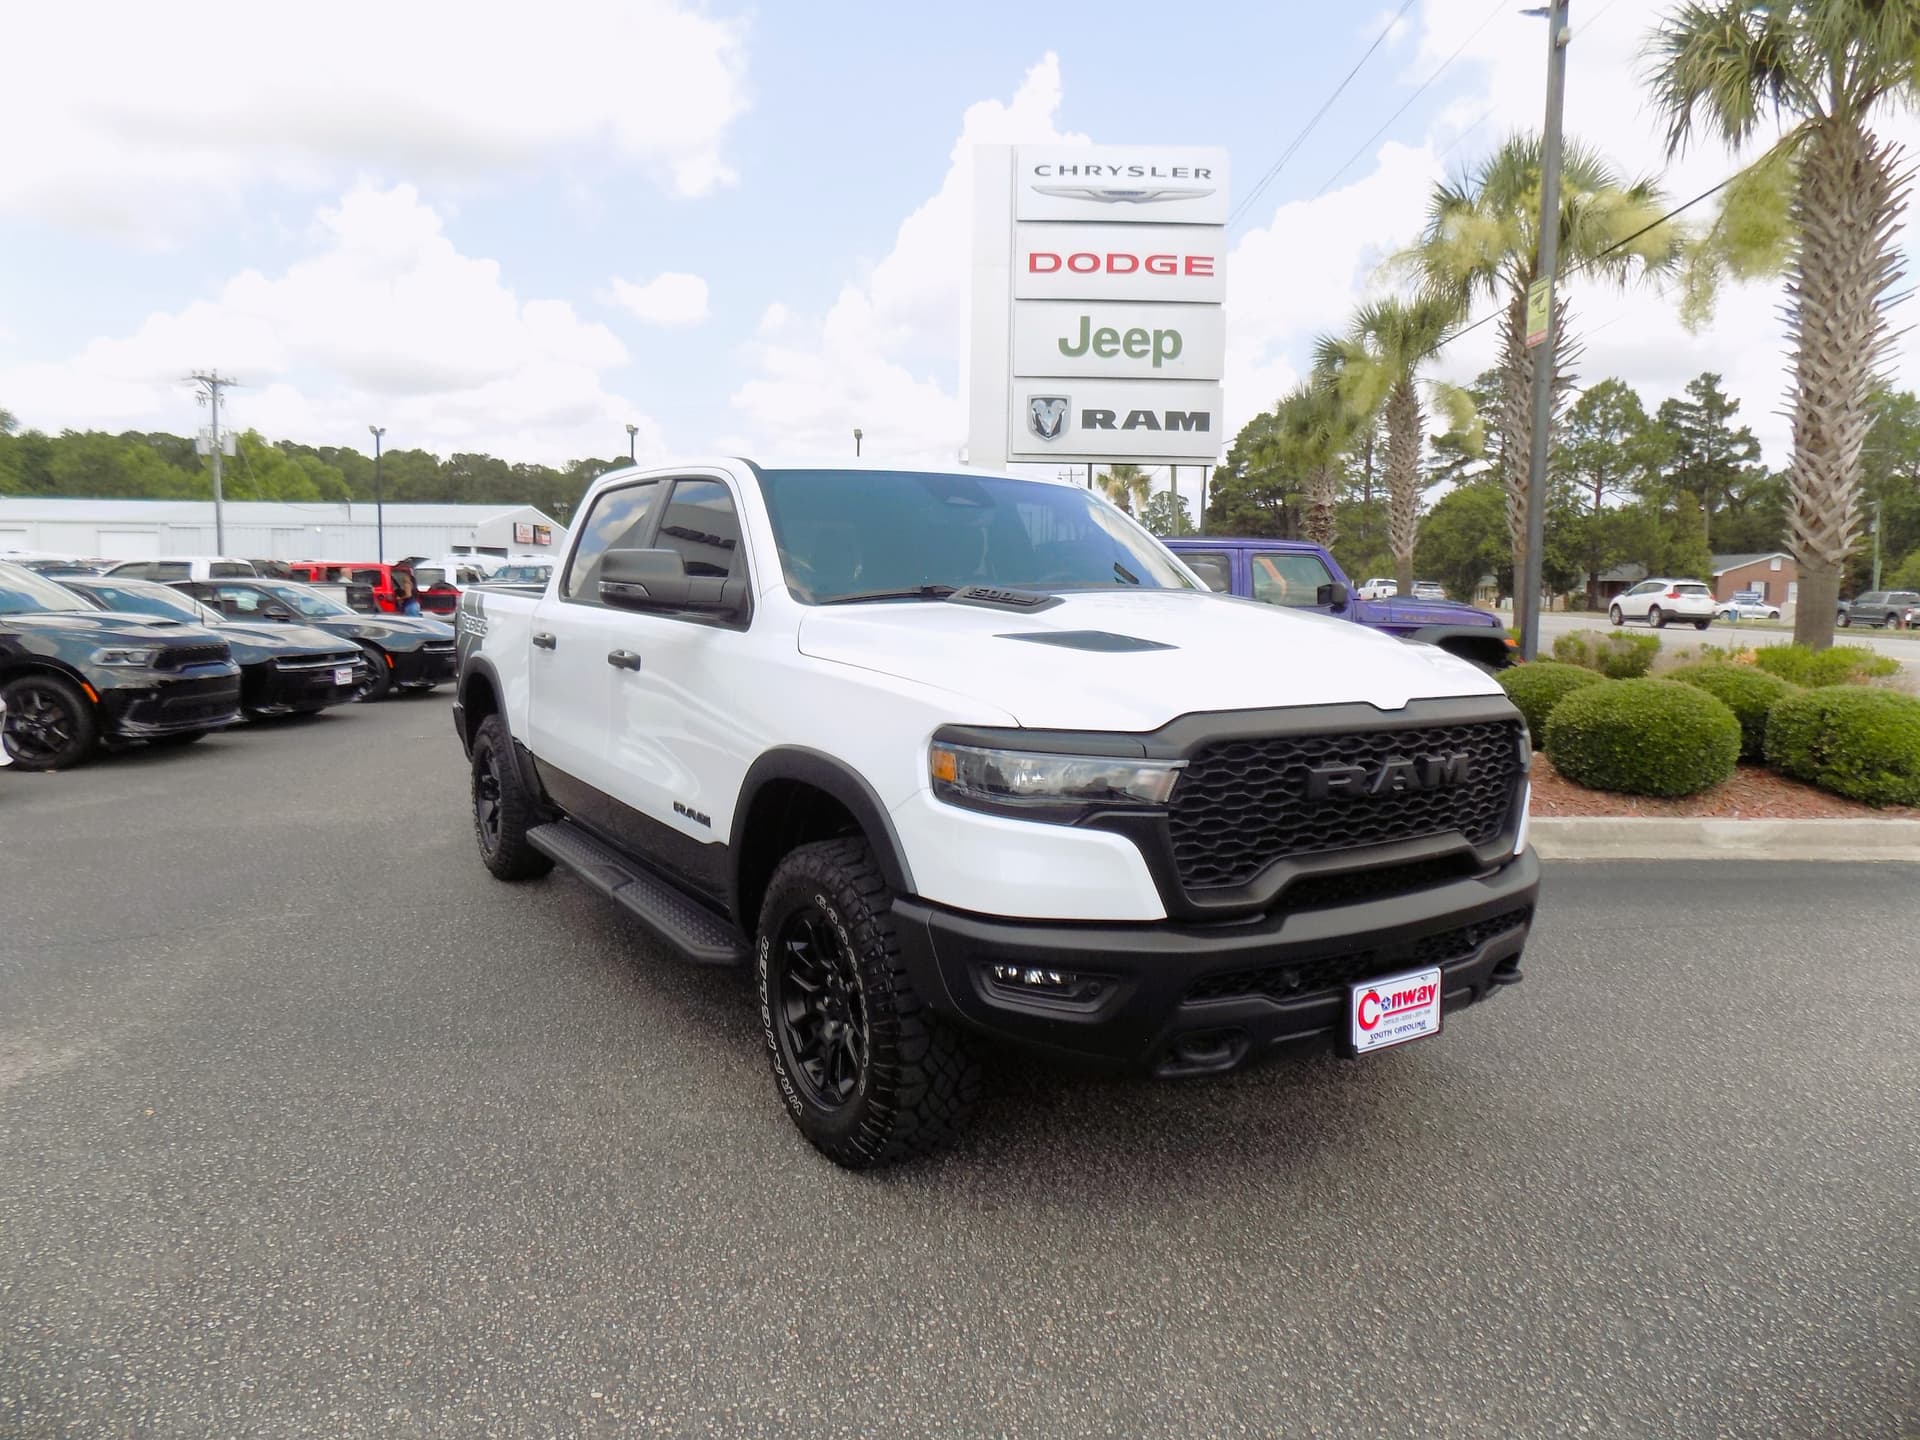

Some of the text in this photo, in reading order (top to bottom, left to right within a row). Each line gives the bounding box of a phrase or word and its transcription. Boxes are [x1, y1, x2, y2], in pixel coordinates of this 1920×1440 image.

[1034, 164, 1213, 181] CHRYSLER
[1028, 252, 1215, 277] DODGE
[1057, 315, 1183, 368] Jeep
[1081, 408, 1211, 433] RAM
[1308, 753, 1469, 799] RAM
[673, 800, 711, 828] RAM
[759, 936, 803, 1116] WRANGLER
[1370, 1020, 1426, 1041] SOUTH CAROLINA
